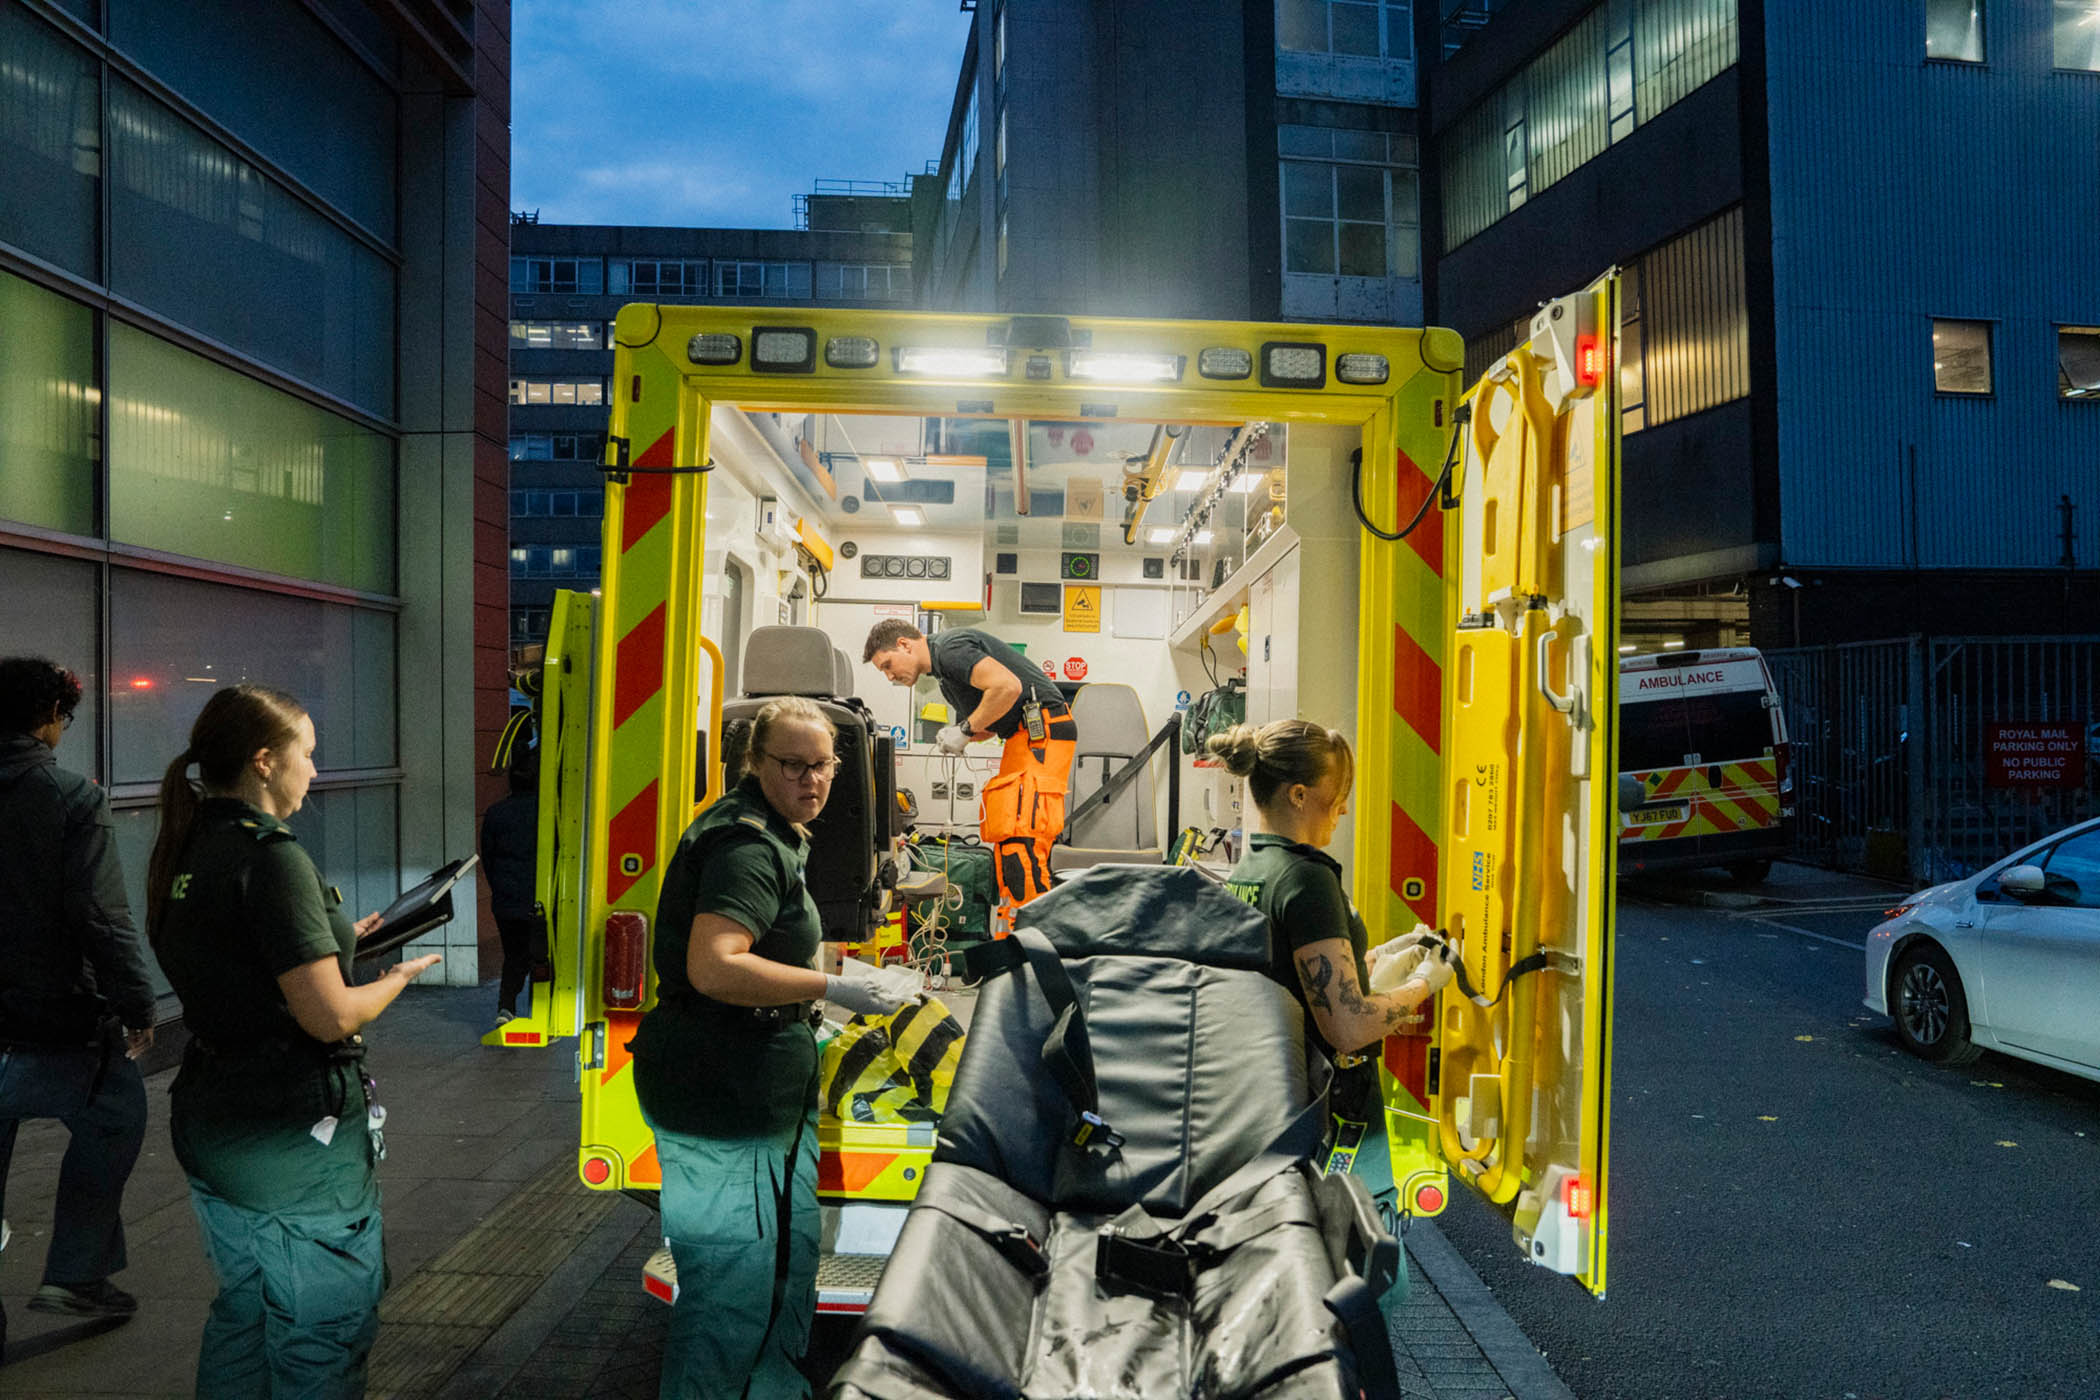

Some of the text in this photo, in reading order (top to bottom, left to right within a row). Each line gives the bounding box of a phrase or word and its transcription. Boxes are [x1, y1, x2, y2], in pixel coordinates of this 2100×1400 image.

[1065, 661, 1087, 672] STOP
[1639, 671, 1724, 689] AMBULANCE
[1999, 729, 2069, 739] ROYAL MAIL
[1993, 741, 2078, 751] PARKING ONLY
[2002, 757, 2066, 767] NO PUBLIC
[2008, 770, 2061, 779] PARKING
[1472, 851, 1484, 890] NHS
